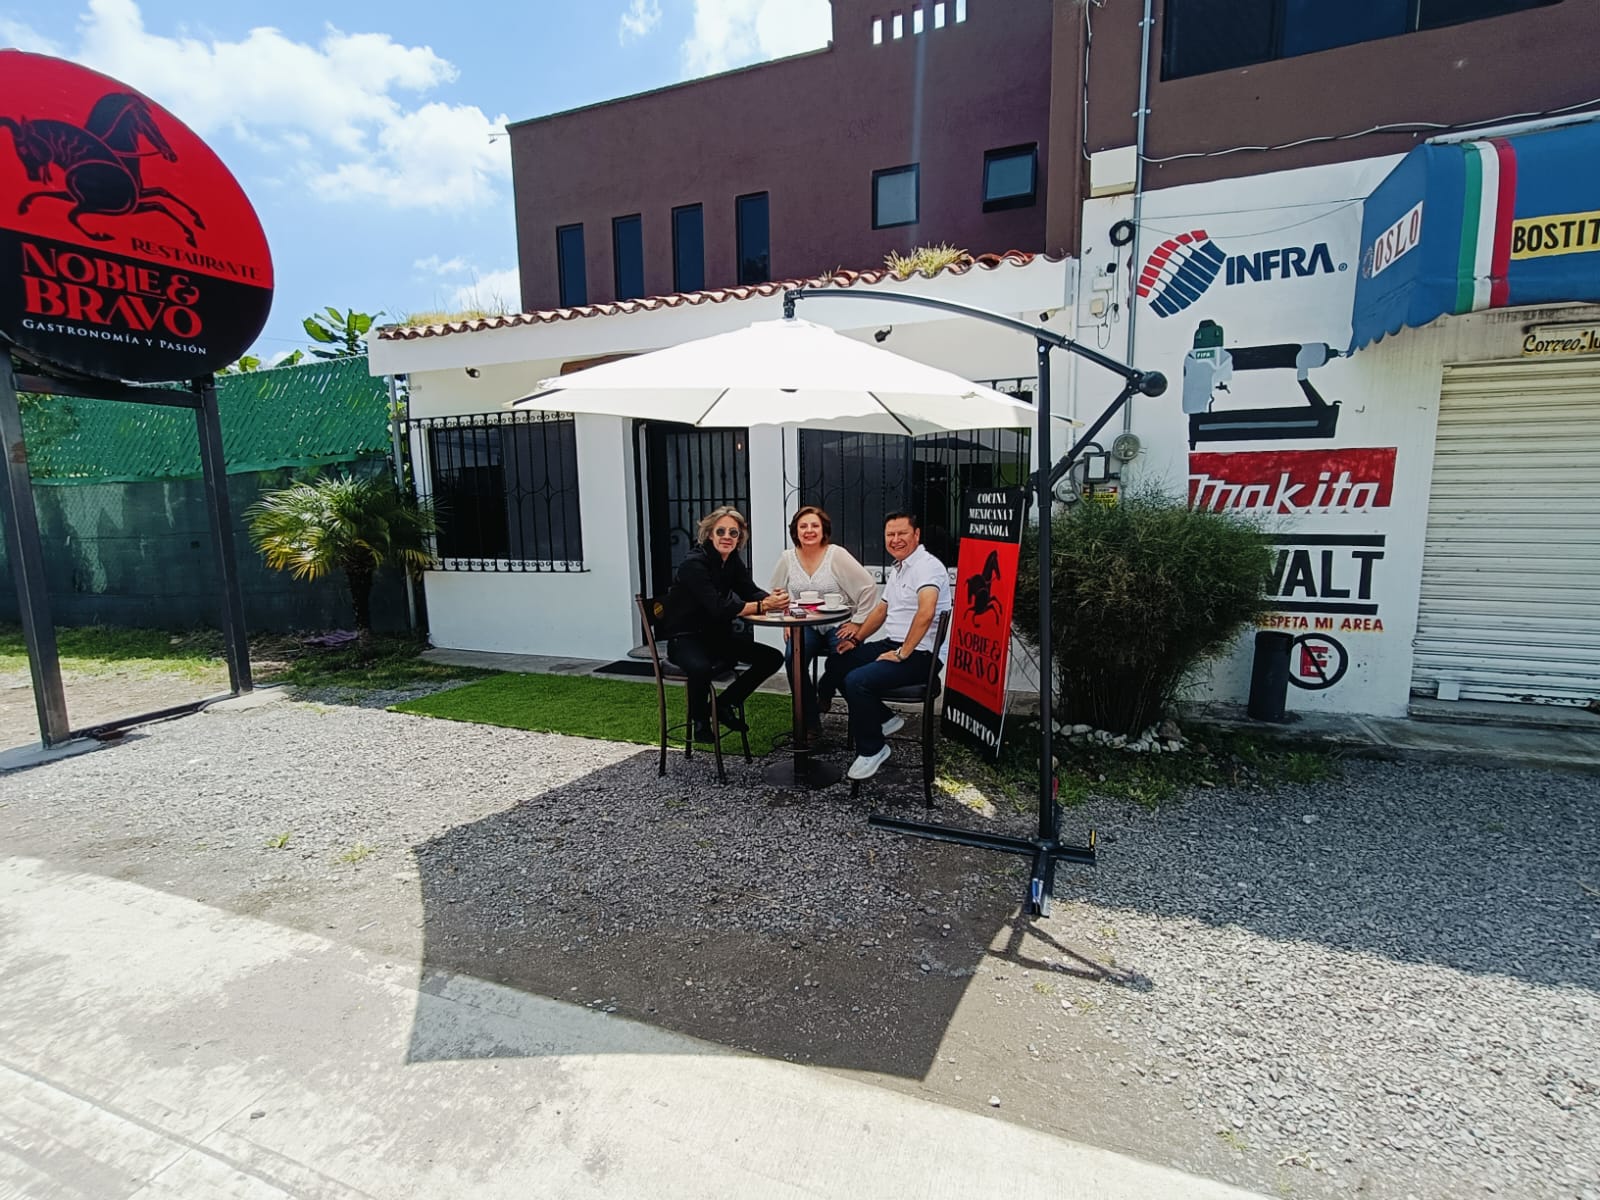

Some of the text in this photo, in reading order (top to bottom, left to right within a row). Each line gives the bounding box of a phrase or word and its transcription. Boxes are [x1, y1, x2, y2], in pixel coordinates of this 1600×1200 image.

[1375, 209, 1420, 272] OSLO
[1512, 218, 1600, 254] BOSTIT
[132, 237, 261, 280] RESTAURANTE
[1226, 242, 1335, 286] INFRA
[20, 274, 203, 339] BRAVO
[167, 274, 201, 306] &
[968, 508, 1007, 520] MEXICANA
[977, 492, 1007, 504] COCINA
[969, 522, 1008, 537] ESPAÑOLA
[1315, 617, 1333, 628] MI
[1341, 618, 1383, 631] AREA
[953, 647, 999, 686] BRAVO
